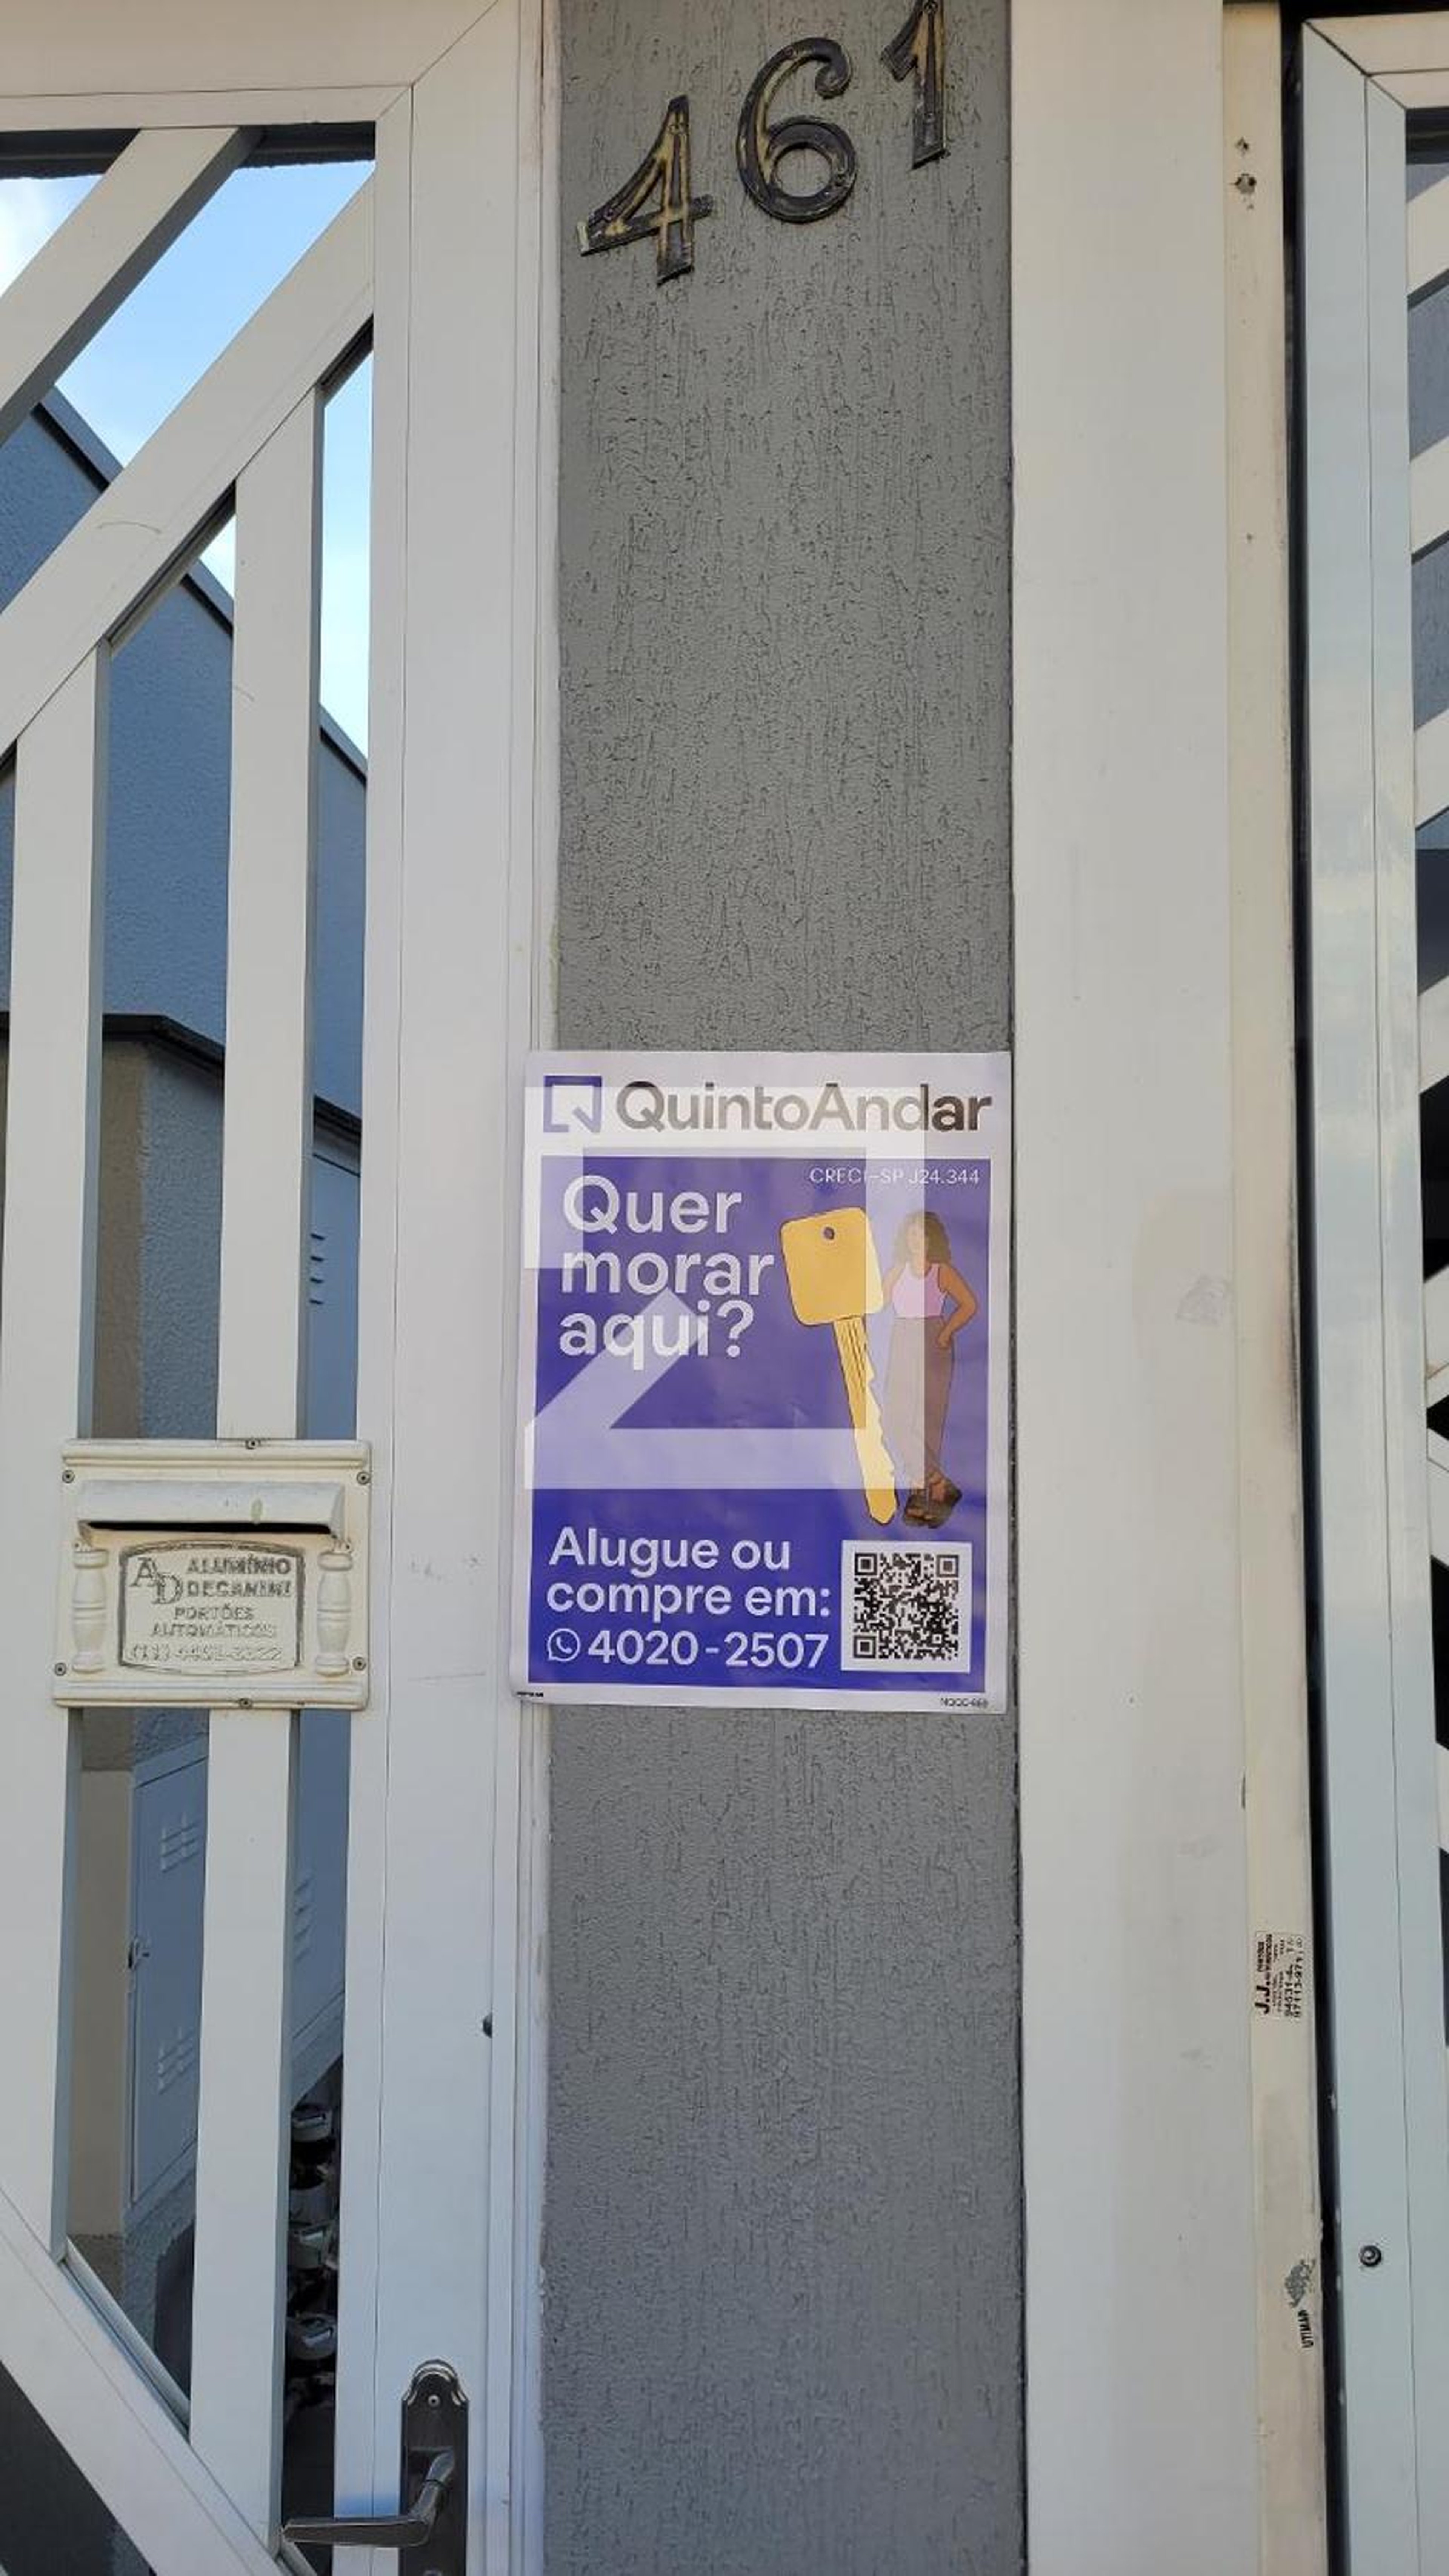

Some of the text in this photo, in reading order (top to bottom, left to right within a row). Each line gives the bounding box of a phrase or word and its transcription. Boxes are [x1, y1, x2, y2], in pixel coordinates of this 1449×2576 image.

[577, 0, 948, 285] 461
[616, 1081, 993, 1132] QuintoAndar
[809, 1167, 981, 1185] CRECI-SP J24.344
[563, 1175, 743, 1235] Quer
[561, 1252, 775, 1296] morar
[559, 1299, 754, 1371] aqui?
[548, 1526, 791, 1578] Alugue ou
[546, 1582, 831, 1623] compre em:
[588, 1629, 829, 1668] 4020-2507
